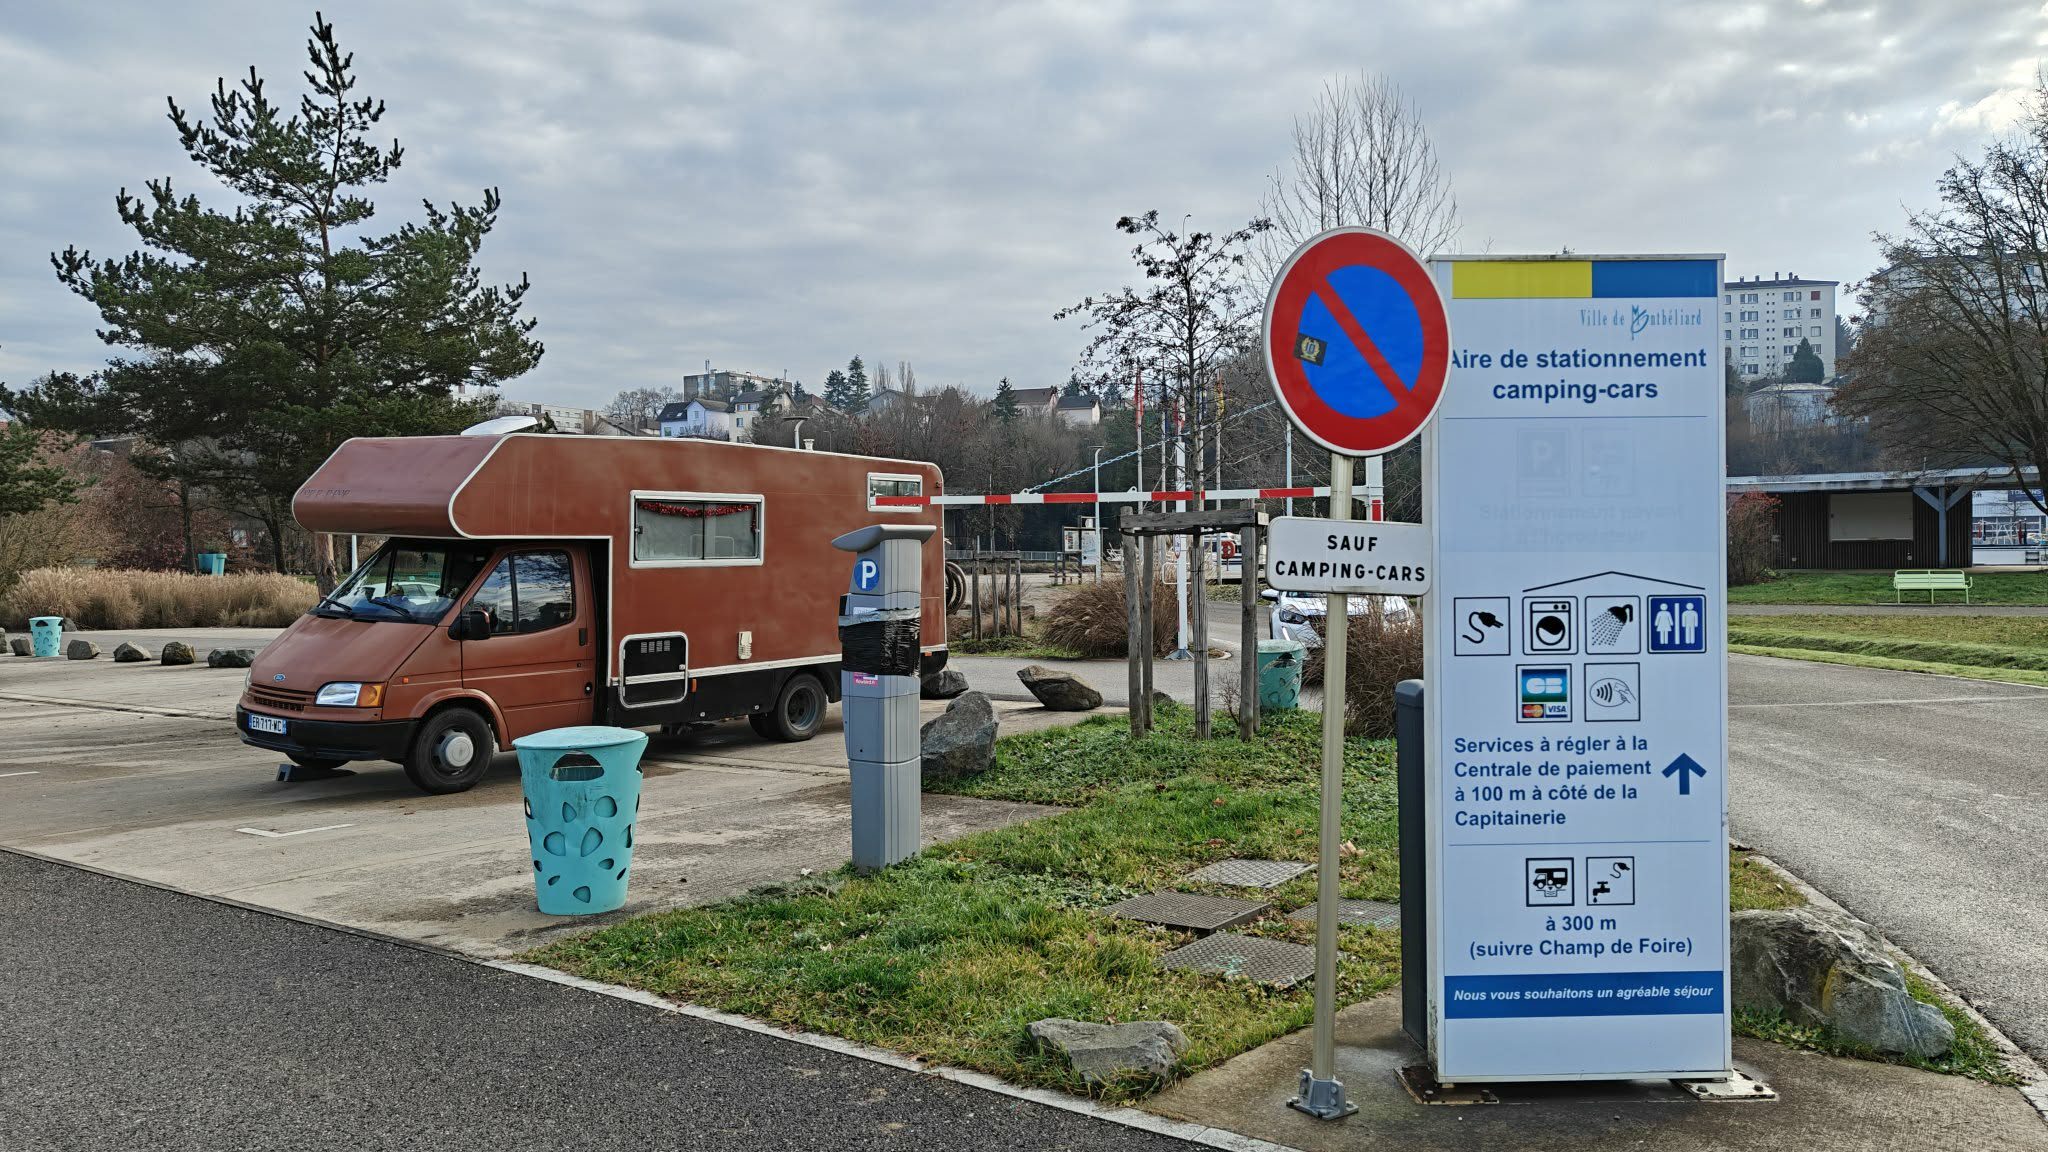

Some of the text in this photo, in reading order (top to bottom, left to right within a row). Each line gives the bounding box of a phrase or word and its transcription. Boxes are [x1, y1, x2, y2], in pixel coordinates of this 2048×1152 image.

[1579, 309, 1608, 326] Ville
[1613, 309, 1625, 326] de
[1452, 348, 1707, 369] Aire de stationnement
[1492, 378, 1659, 404] camping-cars
[1327, 534, 1378, 552] SAUF
[1275, 560, 1426, 582] CAMPING-CARS
[1548, 705, 1567, 713] VISA
[1454, 735, 1648, 756] Services à régler à la
[1454, 760, 1652, 780] Centrale de paiement
[1454, 783, 1638, 802] à 100 m à côté de la
[1454, 809, 1567, 829] Capitainerie
[1545, 915, 1617, 932] à 300 m
[1469, 937, 1693, 961] (suivre Champ de Foire)
[1454, 985, 1714, 1001] Nous vous souhaitons un agréable séjour
